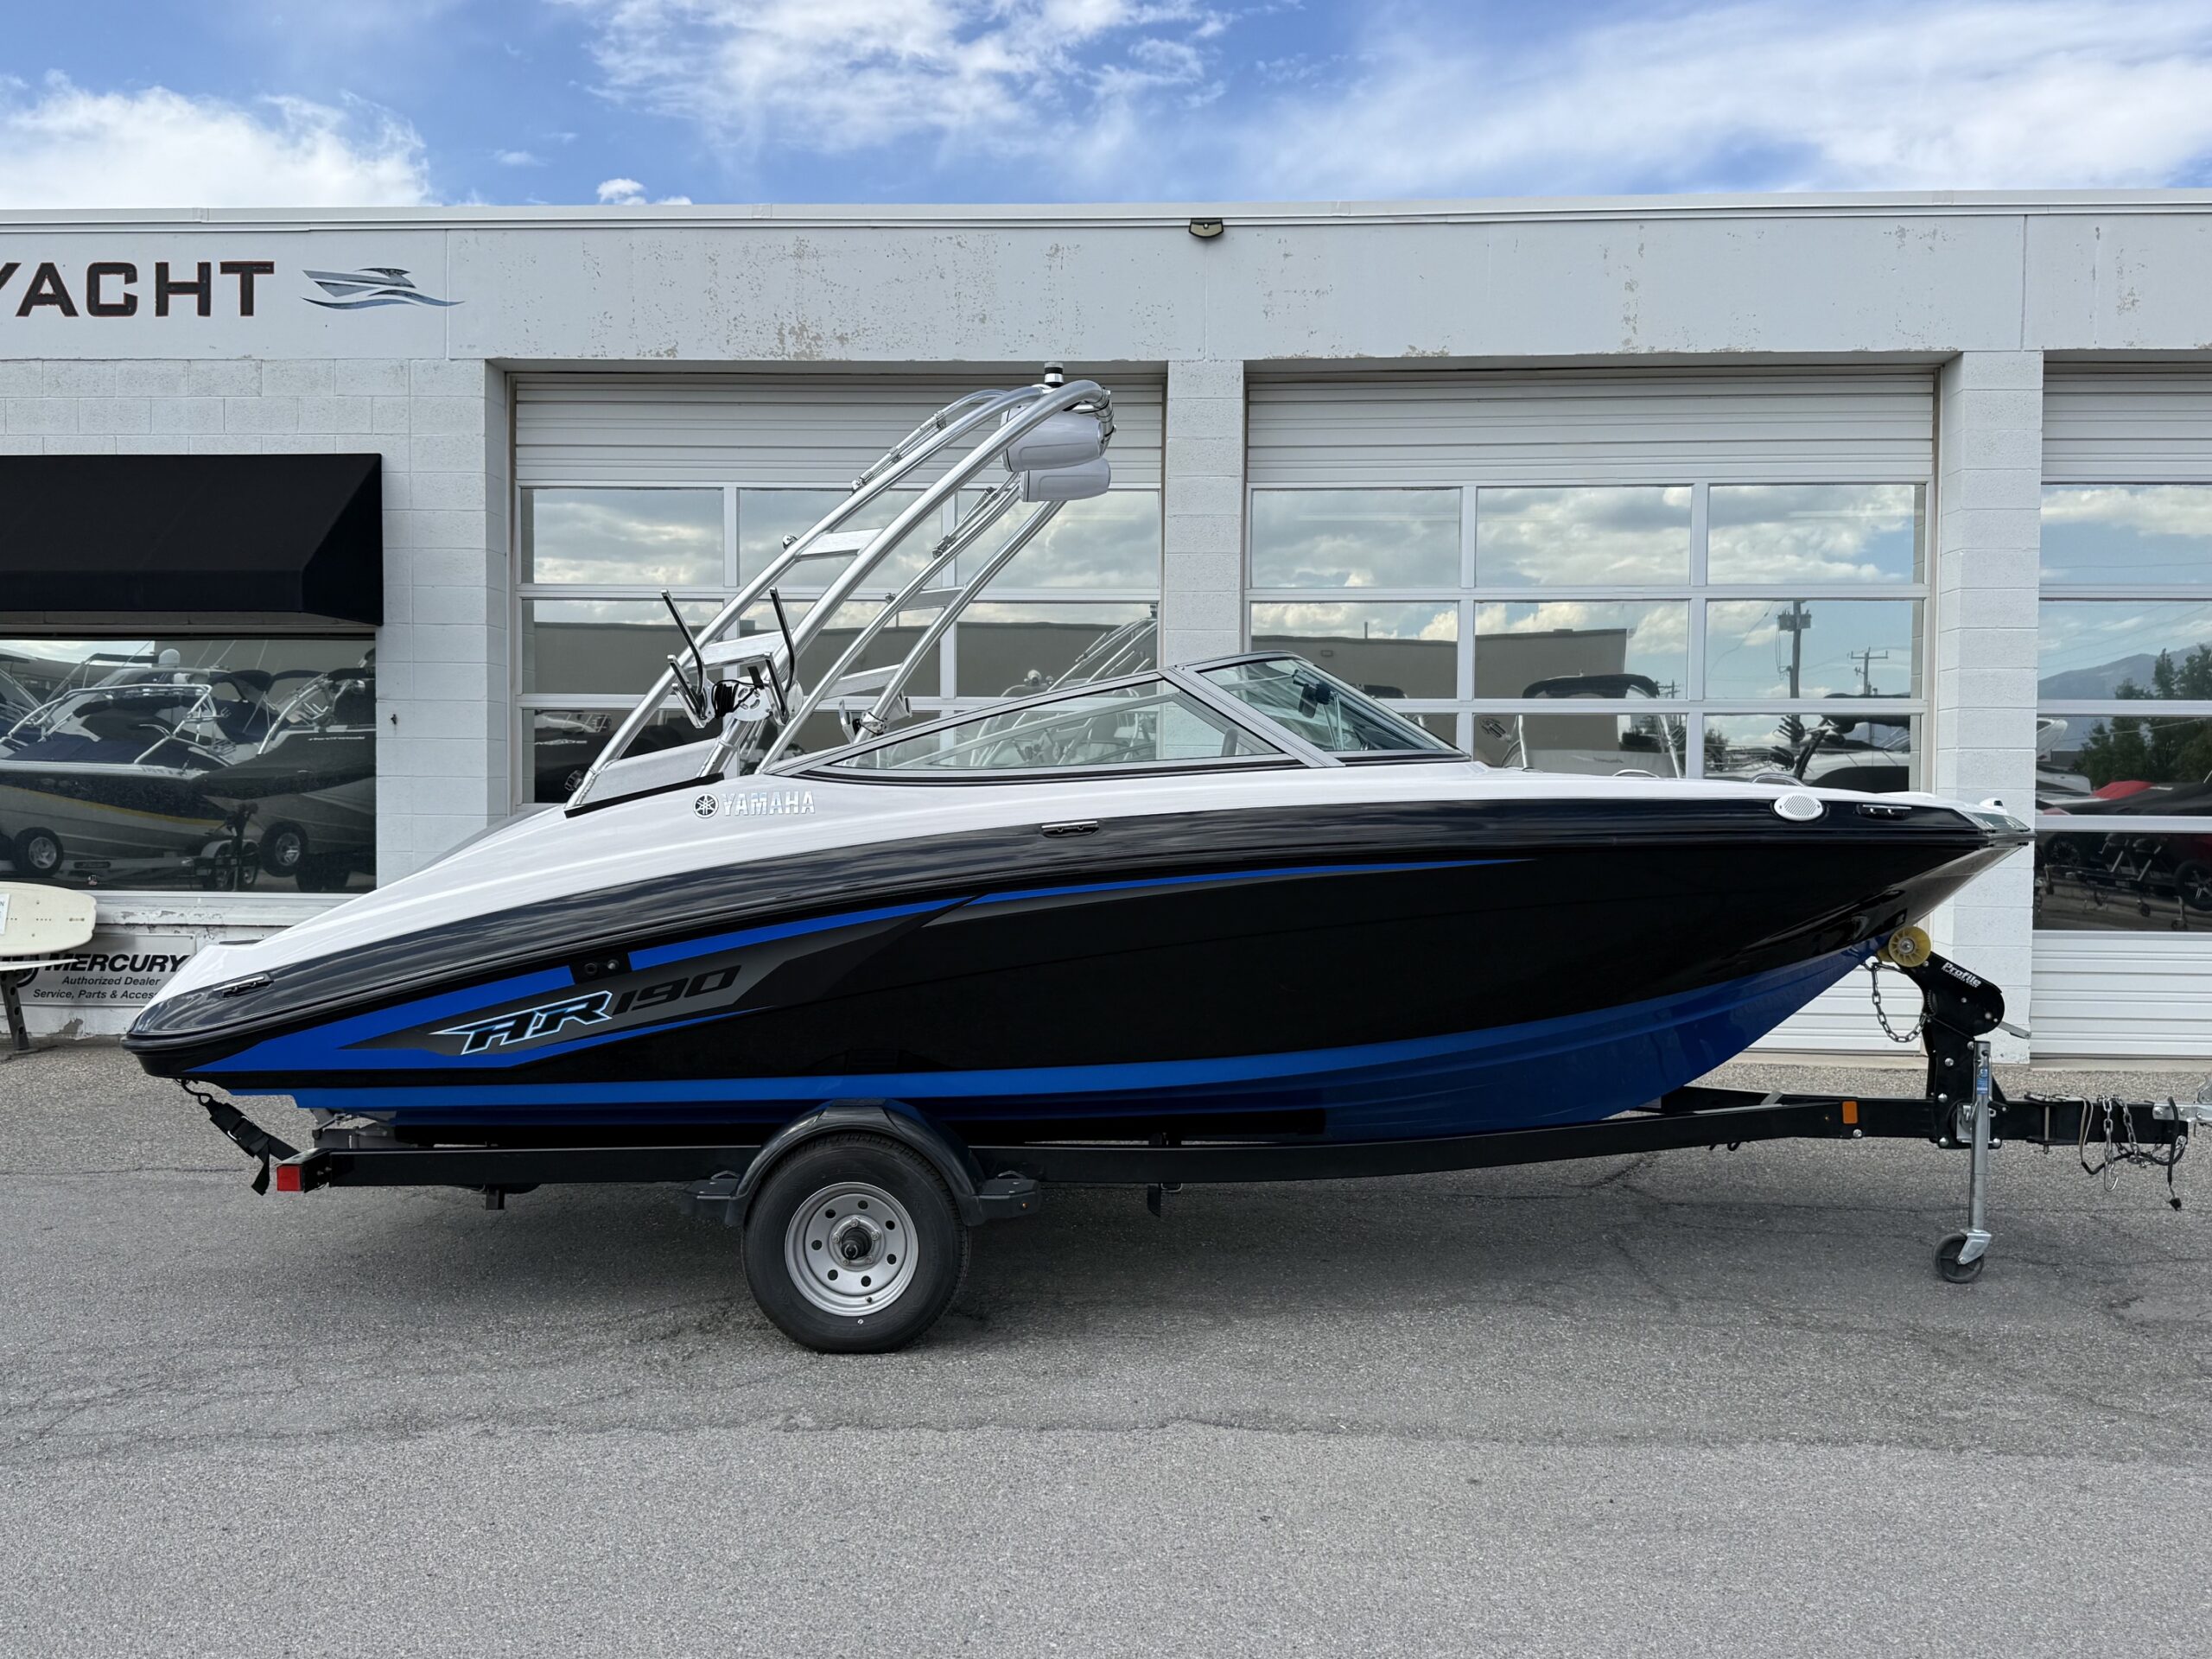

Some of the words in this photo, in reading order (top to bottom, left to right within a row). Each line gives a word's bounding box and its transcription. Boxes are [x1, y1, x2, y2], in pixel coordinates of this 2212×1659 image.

[721, 791, 815, 817] YAMAHA
[45, 953, 190, 972] MERCURY
[61, 976, 122, 985] Authorized
[124, 976, 162, 986] Dealer
[1942, 962, 1981, 986] Profile
[33, 988, 74, 1000] Service,
[78, 989, 107, 999] Parts
[110, 990, 118, 999] &
[120, 990, 157, 999] Acces
